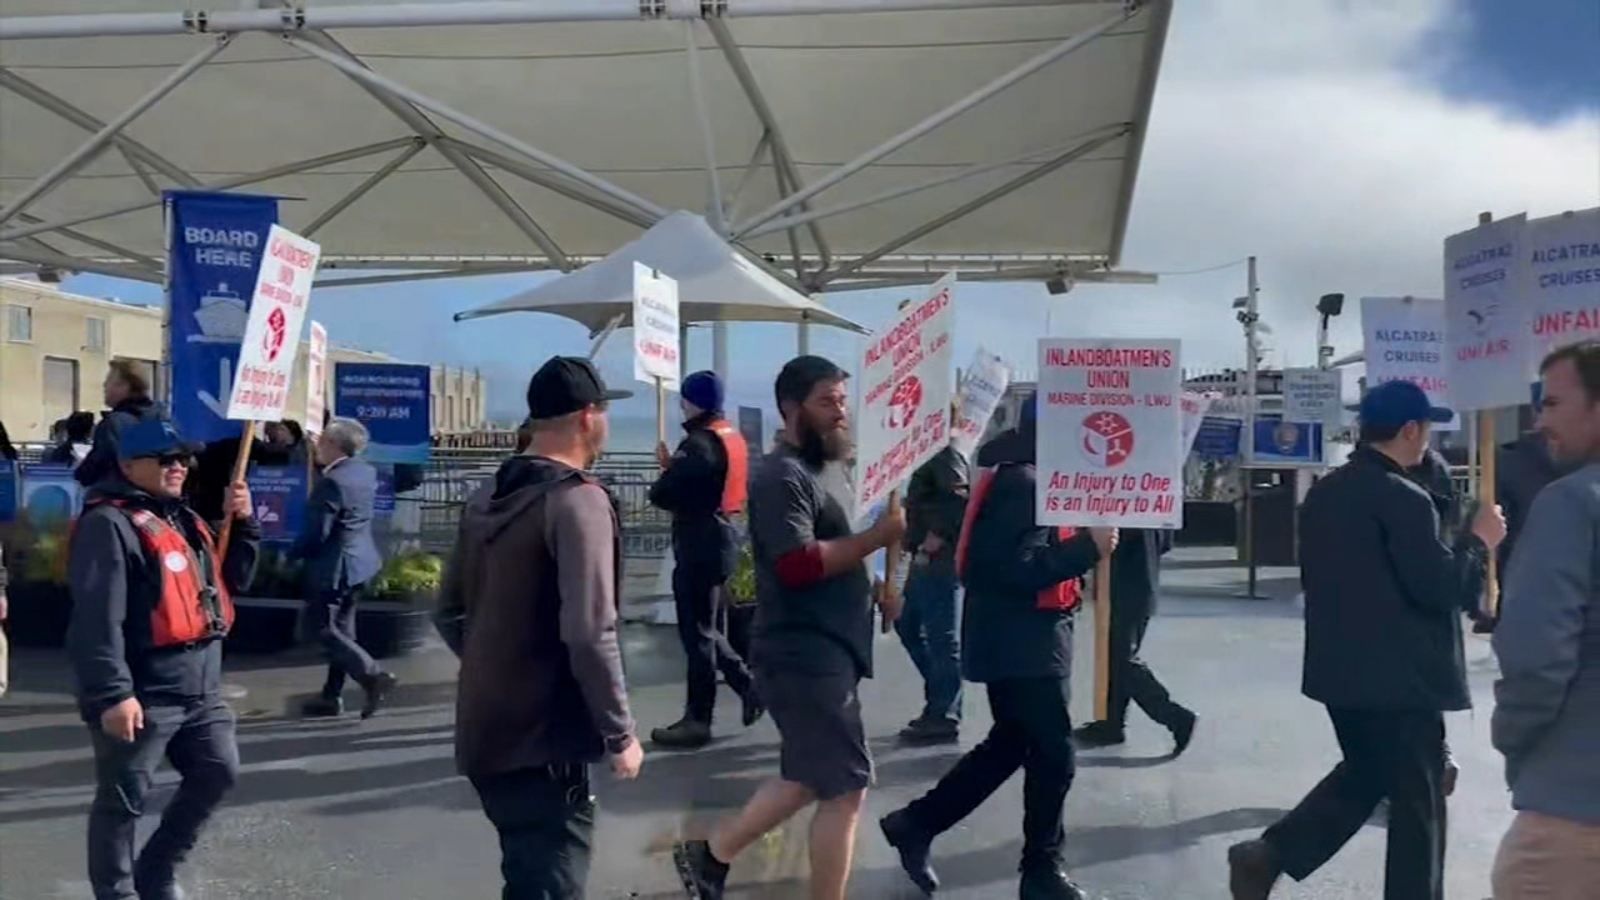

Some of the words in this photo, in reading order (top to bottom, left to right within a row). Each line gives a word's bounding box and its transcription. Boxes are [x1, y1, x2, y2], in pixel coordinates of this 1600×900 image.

[185, 227, 259, 248] BOARD
[196, 248, 251, 268] HERE
[1540, 268, 1600, 288] CRUISES
[1046, 348, 1171, 367] INLANDBOATMEN'S
[1384, 350, 1440, 362] CRUISES
[1087, 370, 1130, 388] UNION
[1048, 392, 1087, 406] MARINE
[1090, 393, 1135, 407] DIVISION
[1144, 394, 1172, 407] ILWU
[1049, 471, 1069, 490] An
[1073, 472, 1118, 494] Injury
[1121, 474, 1136, 491] to
[1140, 472, 1171, 491] One
[1045, 495, 1060, 511] is
[1063, 498, 1082, 512] an
[1086, 495, 1131, 516] Injury
[1134, 496, 1149, 513] to
[1152, 495, 1175, 514] All
